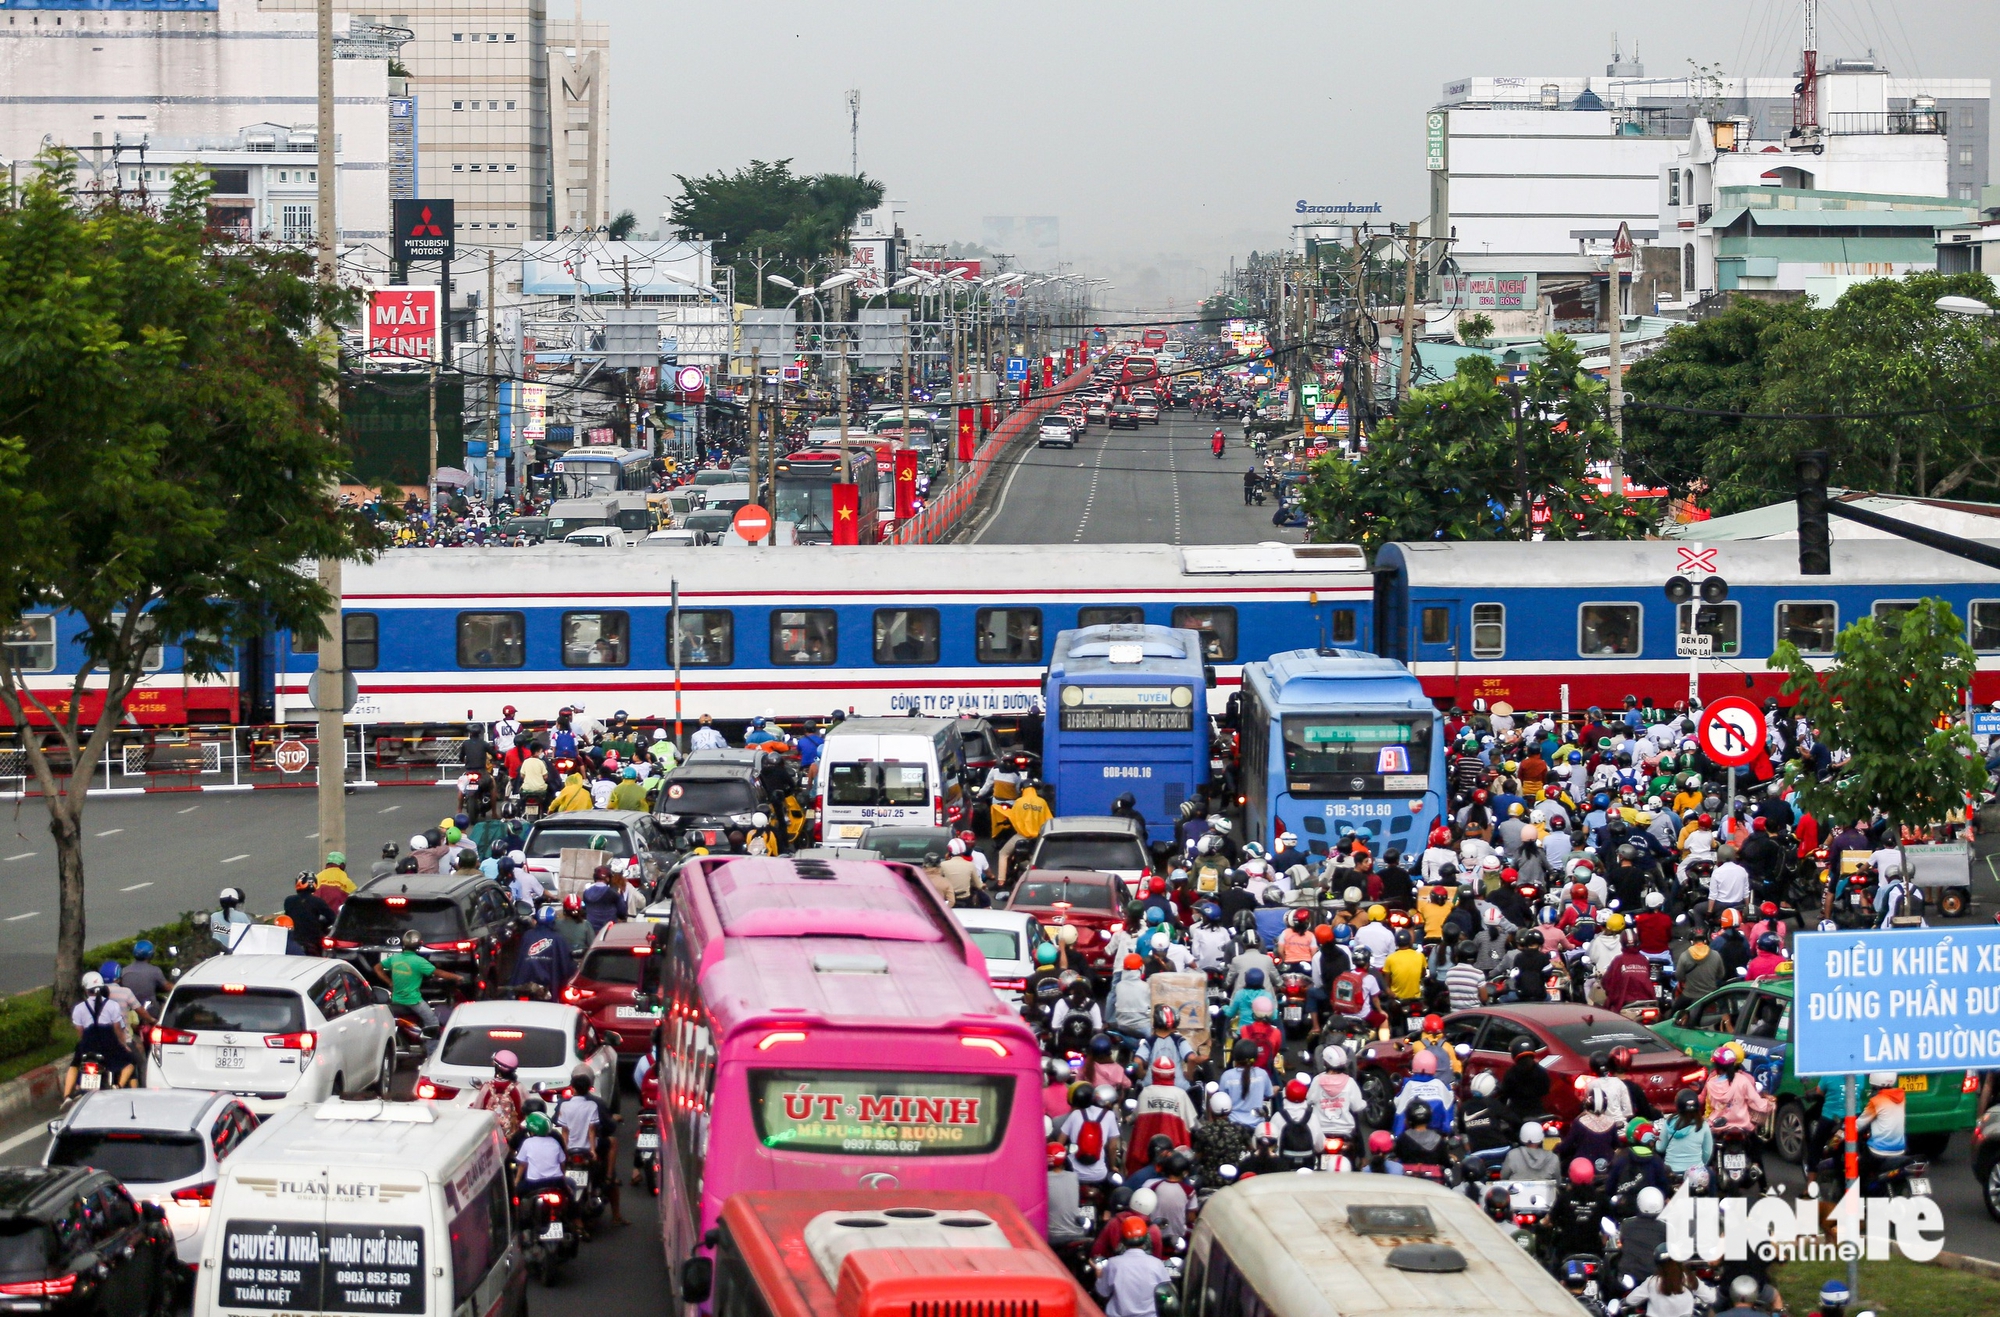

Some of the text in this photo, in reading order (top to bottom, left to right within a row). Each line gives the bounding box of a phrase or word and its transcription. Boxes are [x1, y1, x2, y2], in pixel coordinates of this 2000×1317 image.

[1295, 199, 1382, 213] Sacombank
[404, 239, 449, 247] MITSUBISHI
[376, 292, 429, 325] MẮT
[373, 327, 434, 357] KÍNH
[1482, 678, 1502, 687] SRT
[138, 691, 160, 700] SRT
[891, 692, 920, 710] CÔNG
[924, 695, 937, 709] TY
[940, 695, 954, 710] CP
[1103, 766, 1152, 778] 60B-040.16
[1325, 804, 1391, 817] 51B-319.80
[1825, 940, 1883, 978] ĐIỀU
[1892, 935, 1968, 976] KHIỂN
[1808, 984, 1881, 1020] ĐÚNG
[1889, 979, 1958, 1018] PHẦN
[1863, 1023, 2000, 1062] LÀN ĐƯỜNG
[222, 1047, 239, 1057] 61A
[783, 1083, 981, 1125] ÚT MINH
[279, 1178, 378, 1198] TUẤN KIỆT
[229, 1224, 286, 1261] CHUYỂN
[363, 1229, 387, 1264] CHỞ
[387, 1235, 419, 1265] HÀNG
[228, 1267, 301, 1283] 0903 852 503
[337, 1270, 411, 1286] 0903 852 503
[236, 1284, 292, 1304] TUẤN KIỆT
[345, 1287, 402, 1306] TUẤN KIỆT
